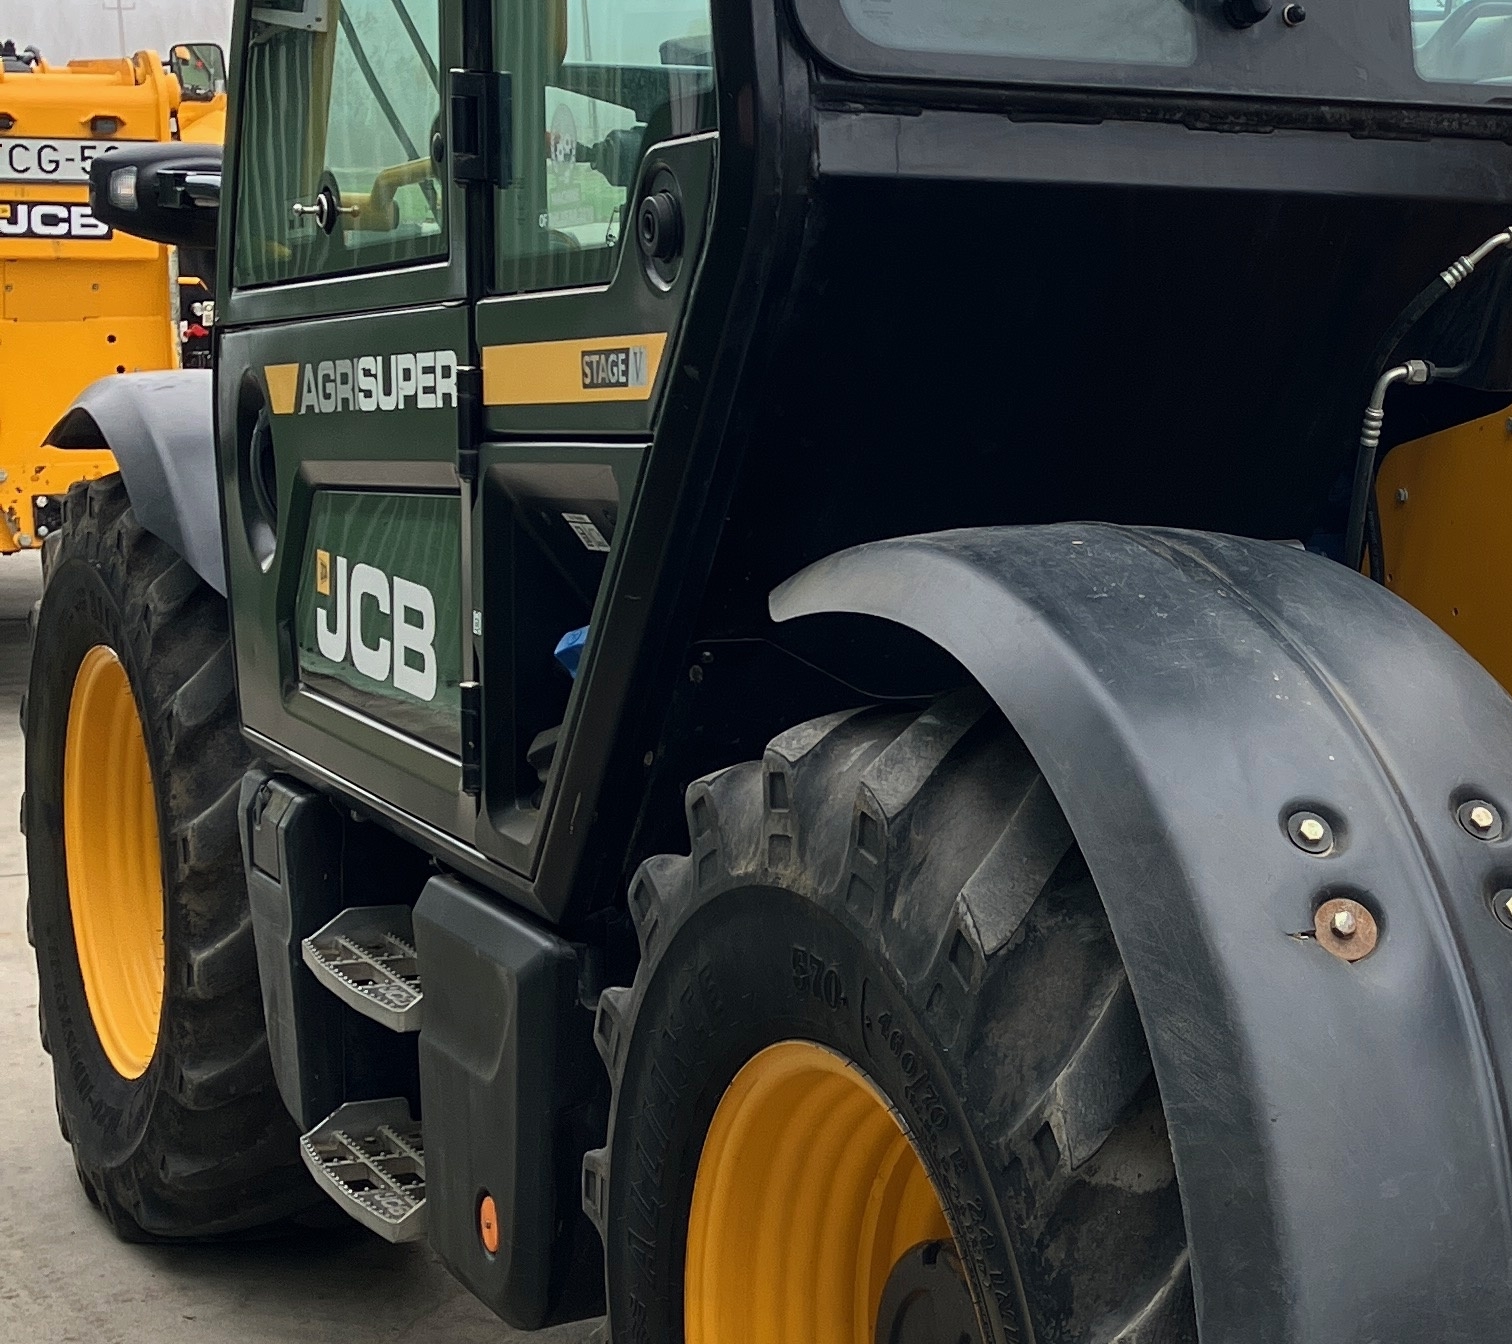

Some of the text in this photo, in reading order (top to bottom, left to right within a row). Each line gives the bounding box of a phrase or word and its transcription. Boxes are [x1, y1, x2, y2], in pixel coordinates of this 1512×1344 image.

[0, 143, 119, 175] CG-5
[0, 204, 110, 236] JCB
[582, 353, 628, 385] STAGE
[316, 555, 438, 702] JCB
